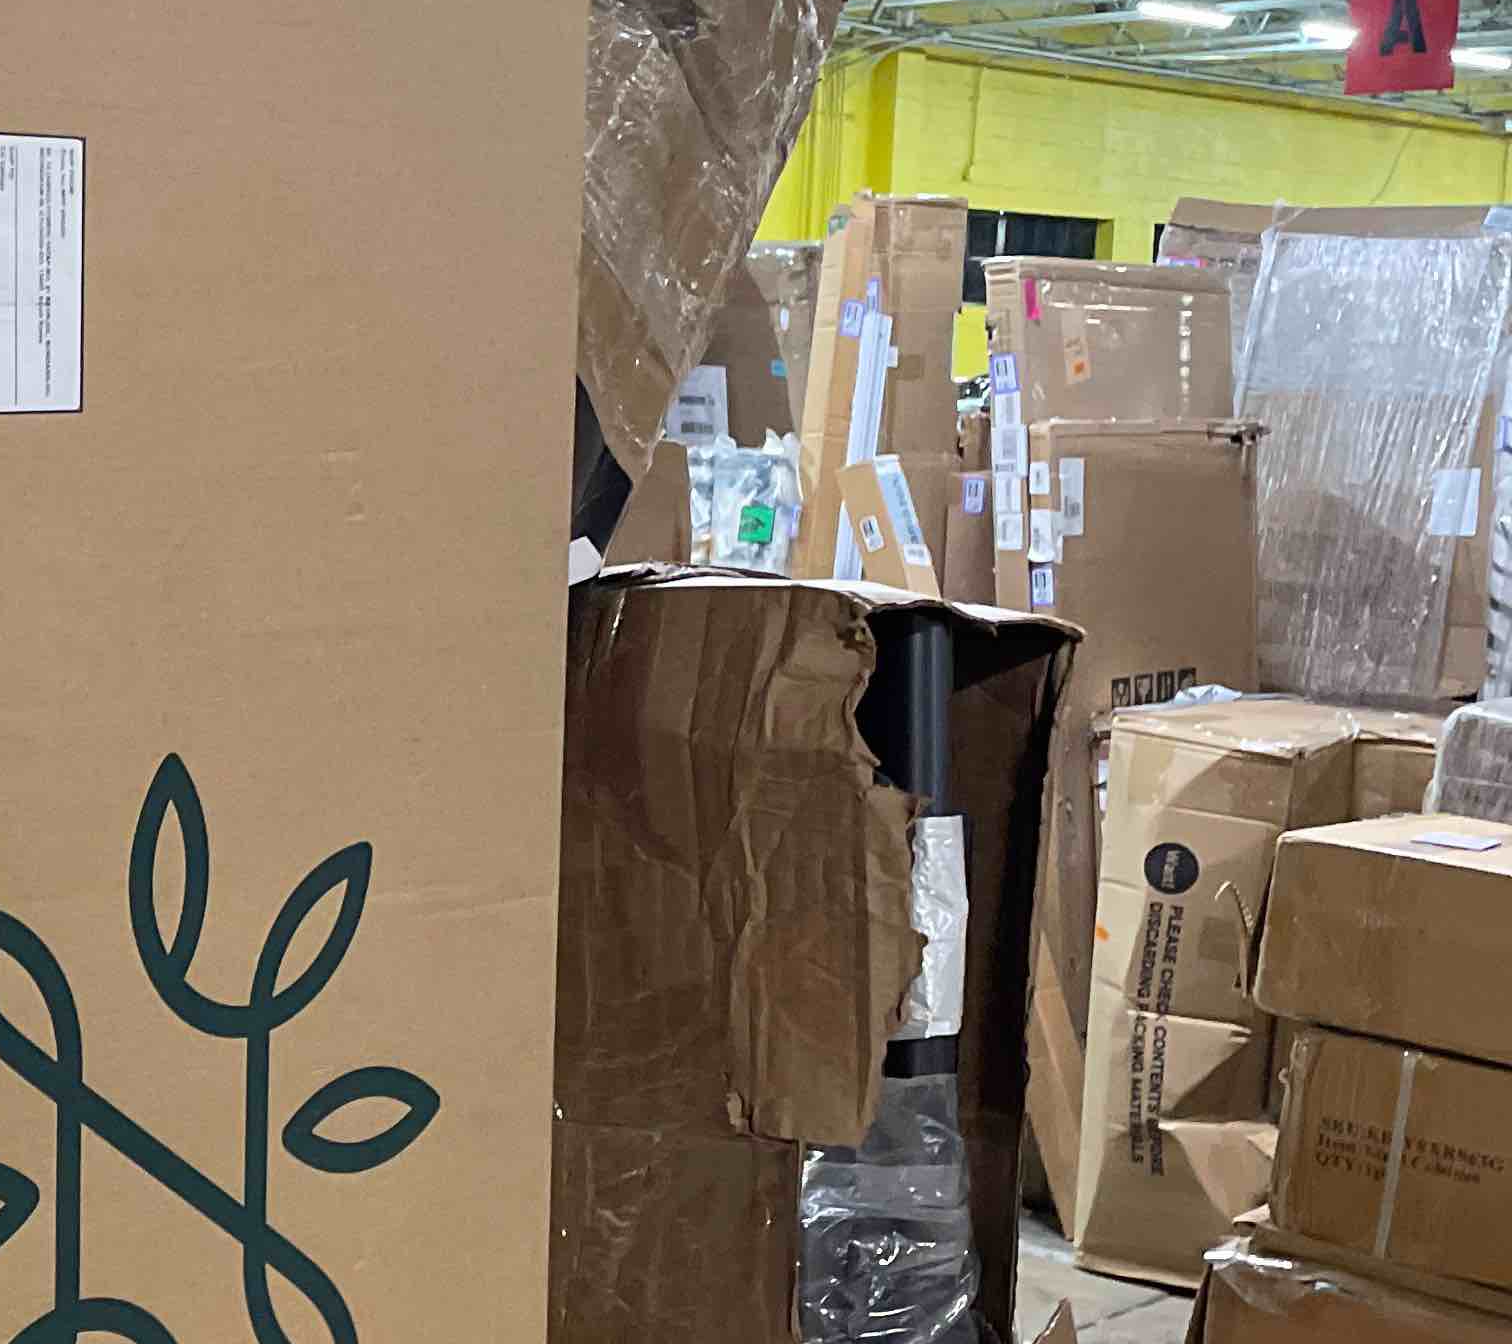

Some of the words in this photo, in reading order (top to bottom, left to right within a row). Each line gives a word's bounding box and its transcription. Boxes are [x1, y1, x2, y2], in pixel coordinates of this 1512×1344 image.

[1136, 901, 1165, 1007] DISCARDING
[1164, 903, 1185, 965] PLEASE
[1147, 1025, 1168, 1117] CONTENTS
